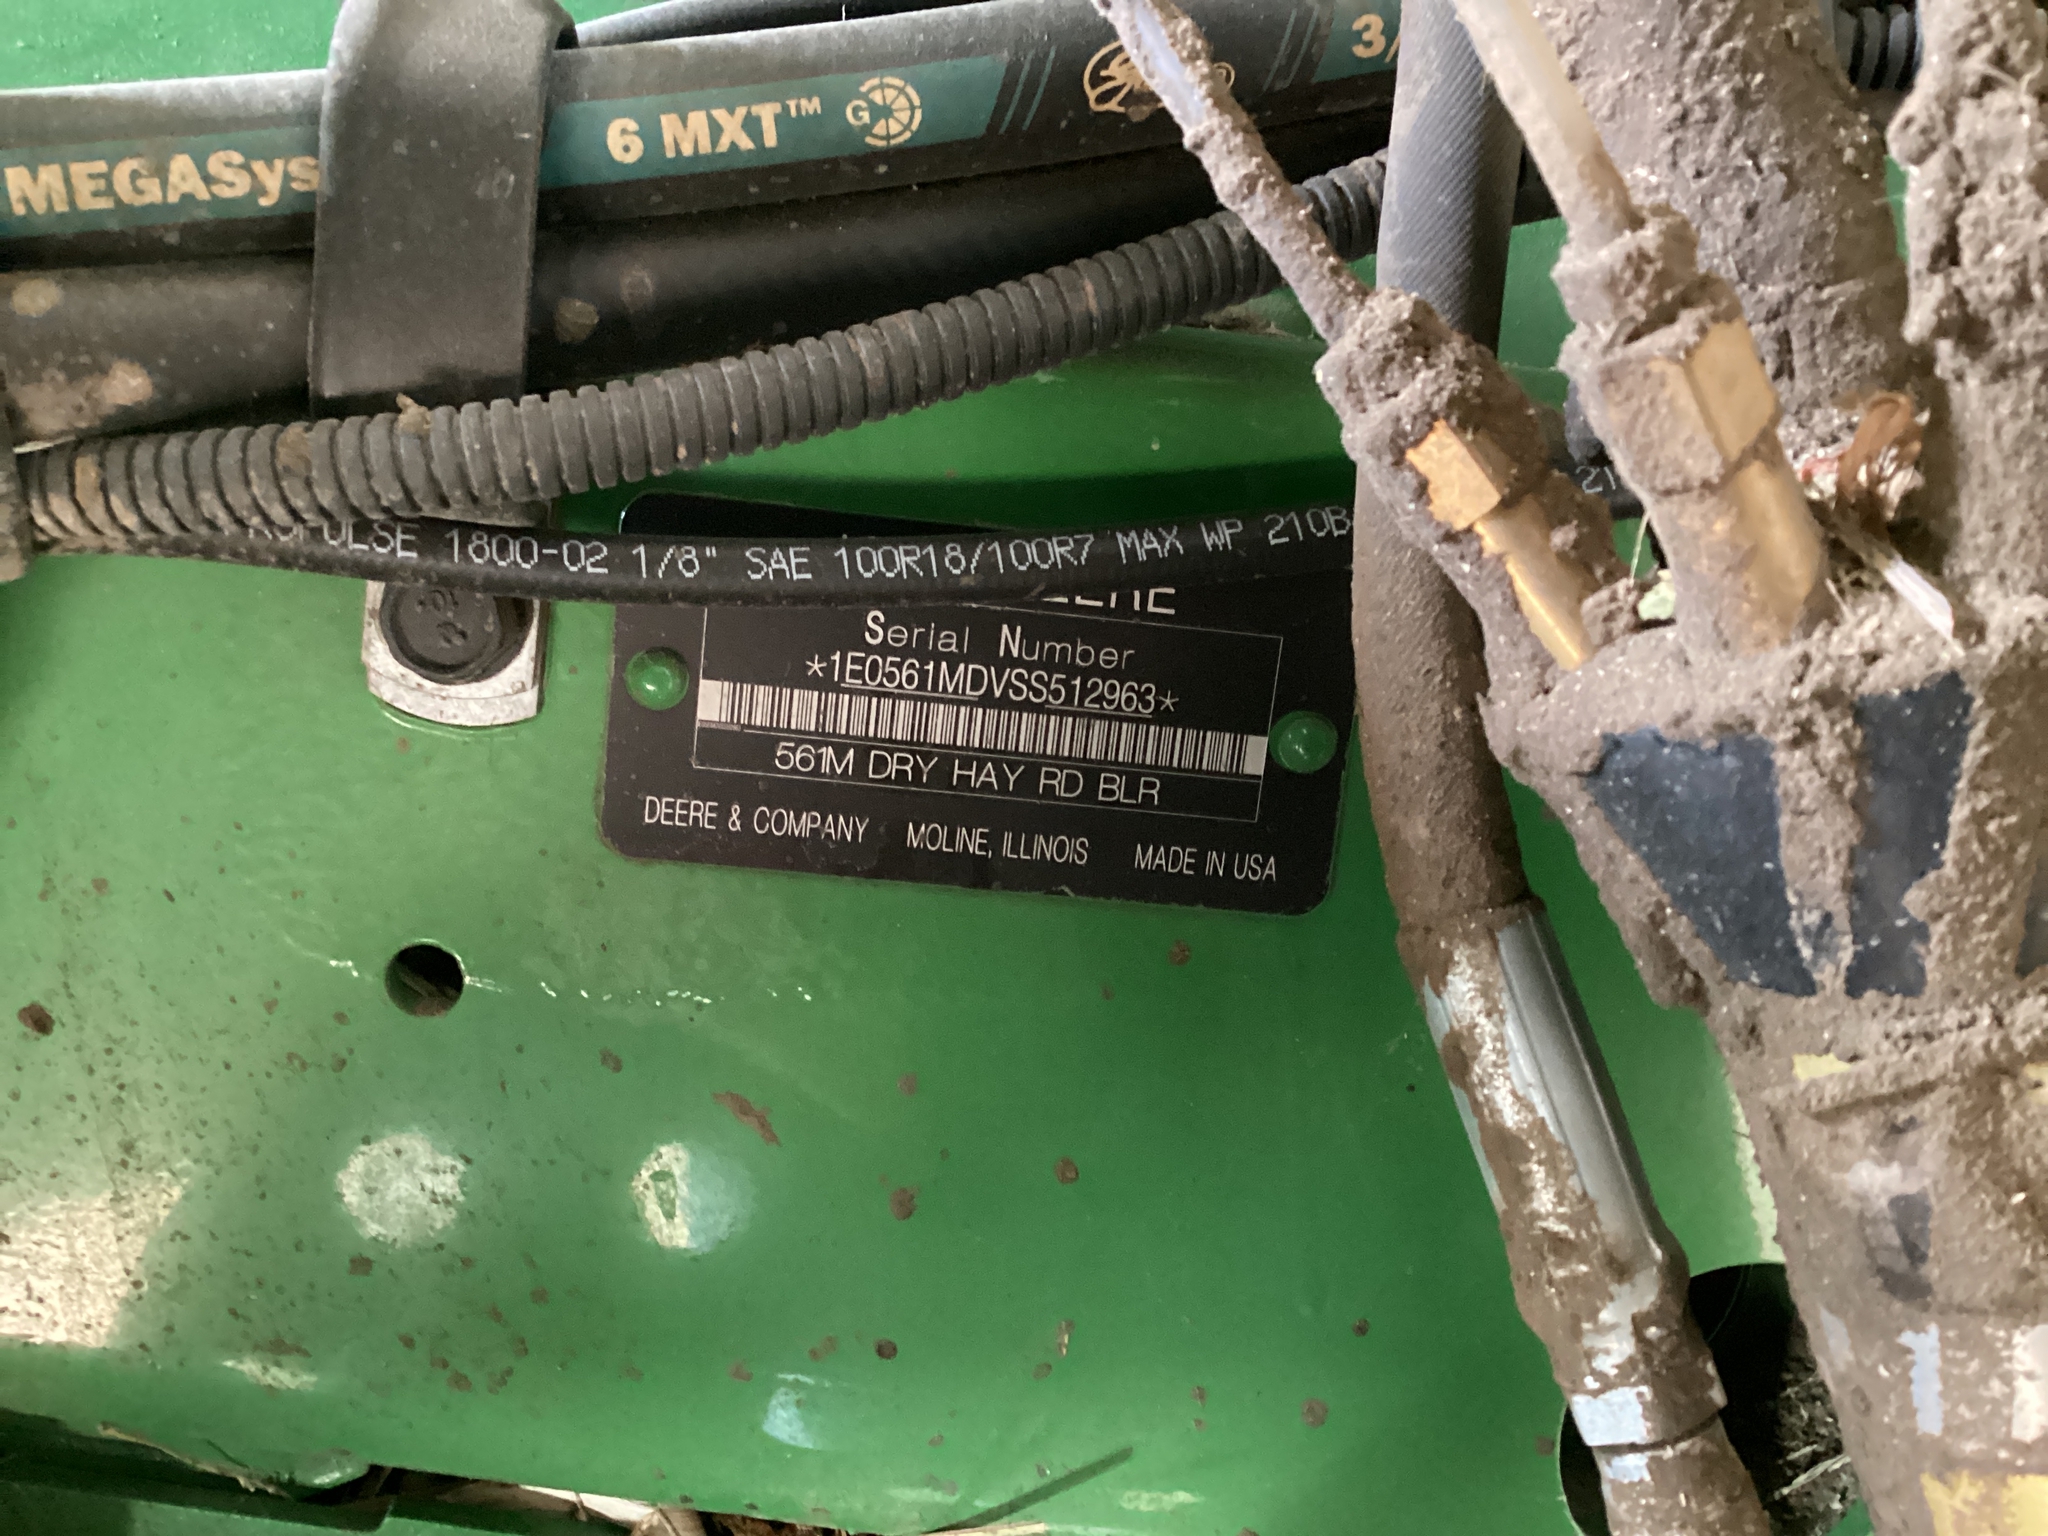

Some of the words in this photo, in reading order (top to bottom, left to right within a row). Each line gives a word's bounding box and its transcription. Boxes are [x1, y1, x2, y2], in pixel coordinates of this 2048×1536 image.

[606, 117, 644, 164] 6
[4, 148, 320, 217] MEGASys
[446, 528, 609, 575] 1800-02
[632, 543, 717, 580] 1/8"
[746, 545, 813, 581] SAE
[834, 533, 1096, 580] 100R18/100R7
[1116, 527, 1186, 565] MAX
[1202, 518, 1244, 554] WP
[863, 609, 970, 654] Serial
[999, 623, 1136, 670] Number
[774, 741, 854, 776] 561M
[868, 749, 939, 784] DRY
[952, 757, 1025, 793] HAY
[1039, 767, 1084, 799] RD
[1097, 773, 1161, 806] BLR
[644, 796, 719, 831] DEERE
[728, 804, 742, 833] &
[753, 806, 870, 844] COMPANY
[906, 821, 993, 860] MOLINE,
[1002, 830, 1090, 866] ILLINOIS
[1133, 843, 1198, 876] MADE
[1205, 850, 1227, 879] IN
[1233, 852, 1278, 883] USA
